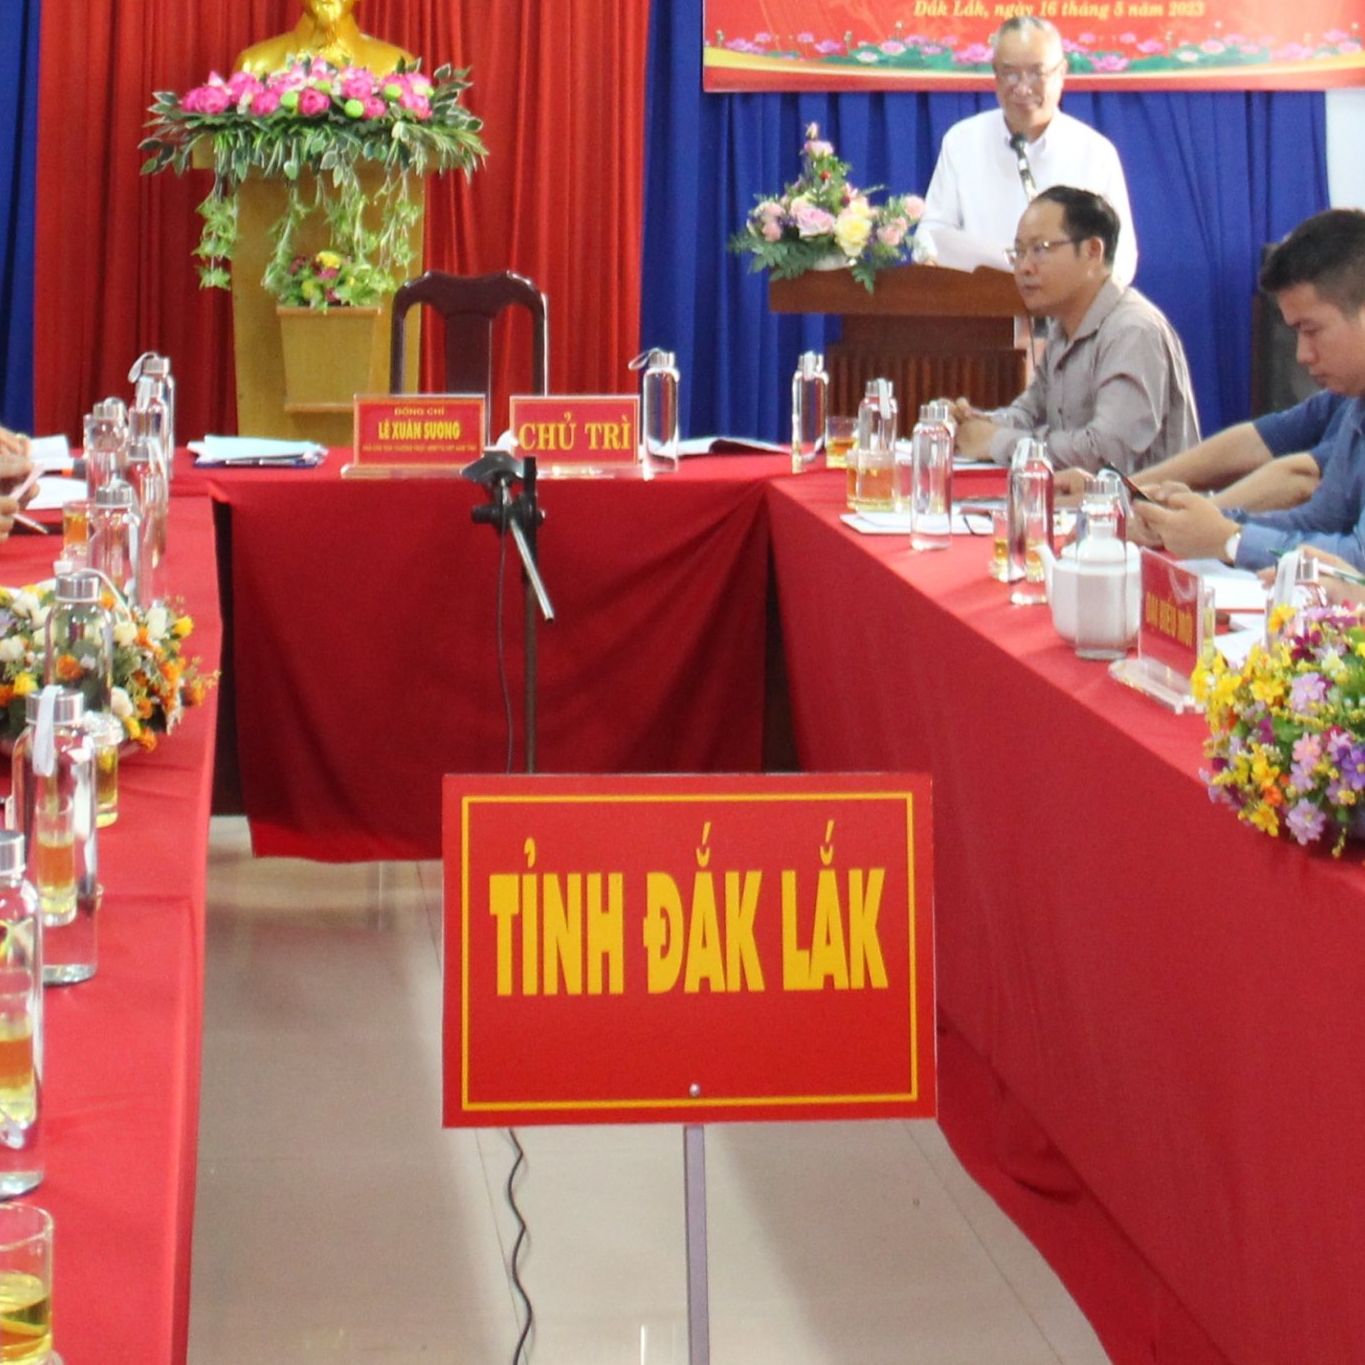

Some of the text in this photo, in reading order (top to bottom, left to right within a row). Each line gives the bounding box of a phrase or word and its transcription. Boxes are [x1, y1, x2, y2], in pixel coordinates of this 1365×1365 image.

[994, 1, 1033, 19] ngày
[1040, 0, 1057, 16] 16
[1061, 0, 1109, 20] tháng
[1128, 2, 1163, 16] năm
[1168, 0, 1205, 17] 2023
[392, 419, 422, 440] XUÂN
[518, 412, 632, 450] CHỦ TRÌ
[489, 820, 889, 996] TỈNH ĐẮK LẮK
